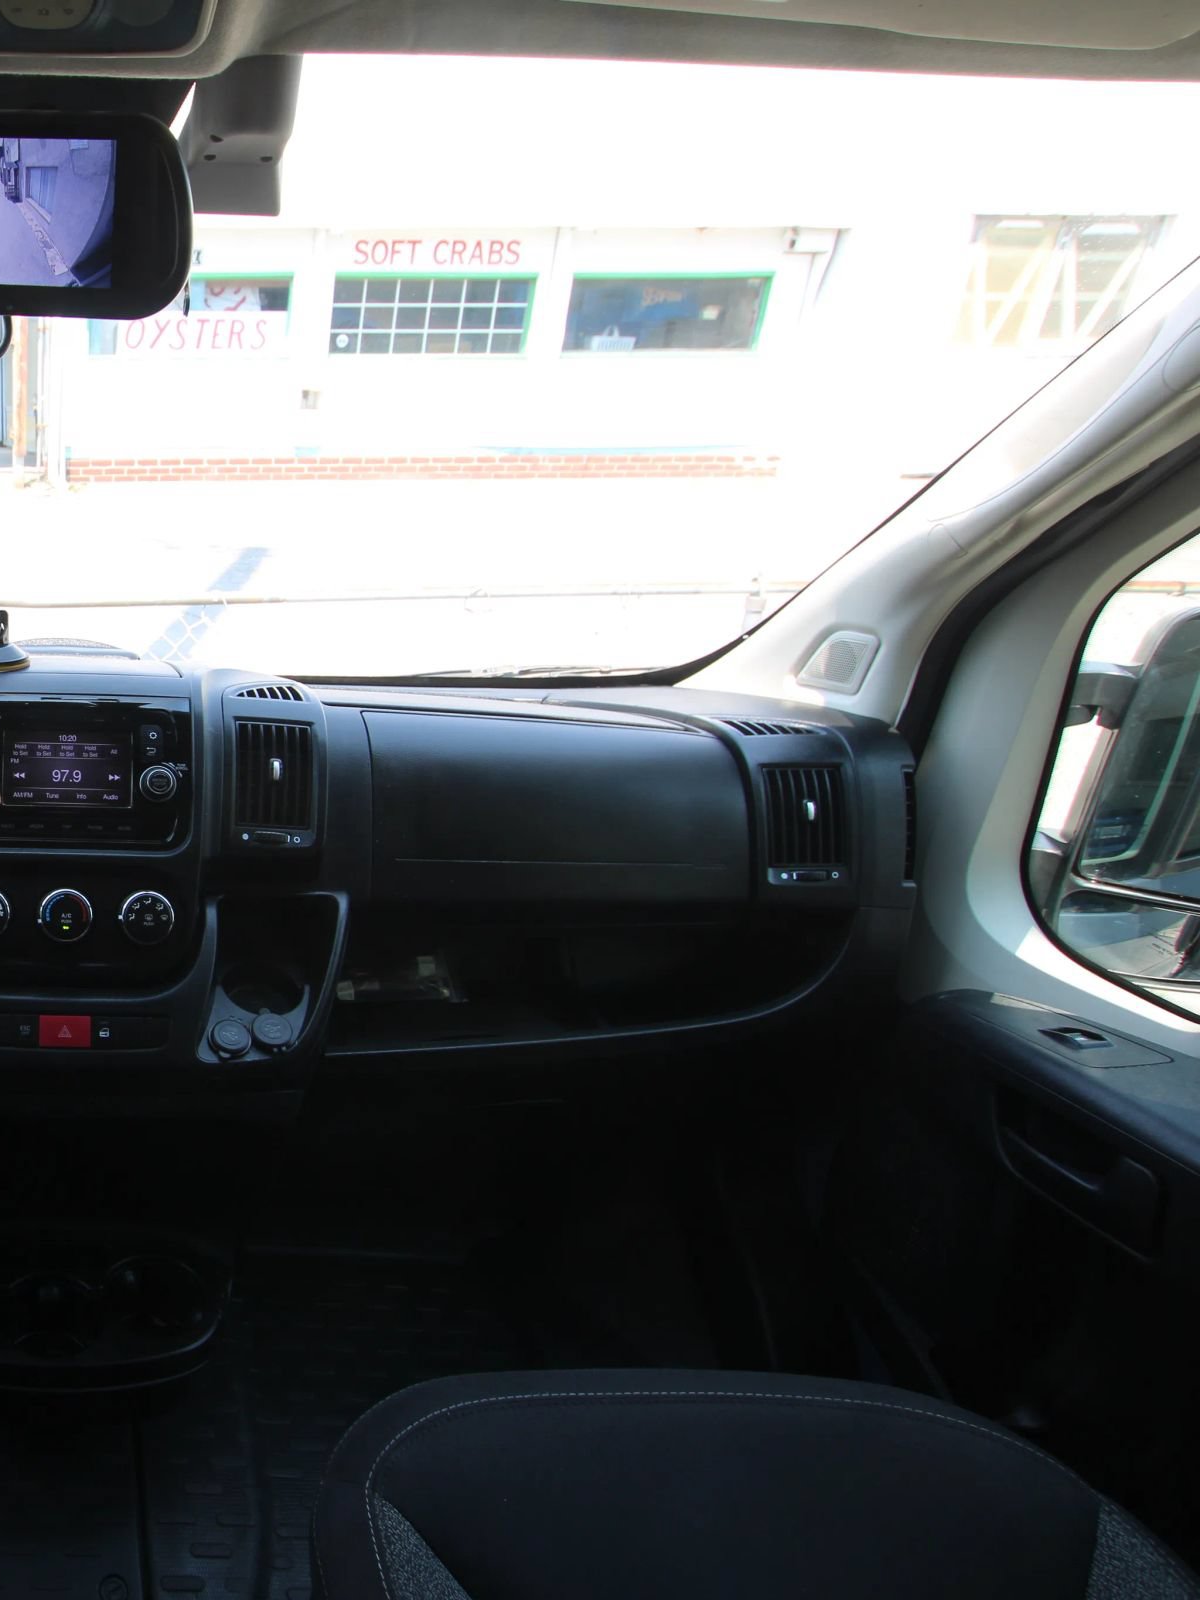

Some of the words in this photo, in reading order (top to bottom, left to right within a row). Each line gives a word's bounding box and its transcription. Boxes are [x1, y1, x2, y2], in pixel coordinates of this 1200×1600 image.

[354, 239, 422, 265] SOFT
[433, 239, 521, 265] CRABS
[126, 319, 267, 350] OYSTERS
[52, 769, 82, 783] 97.9
[103, 793, 118, 801] Audio
